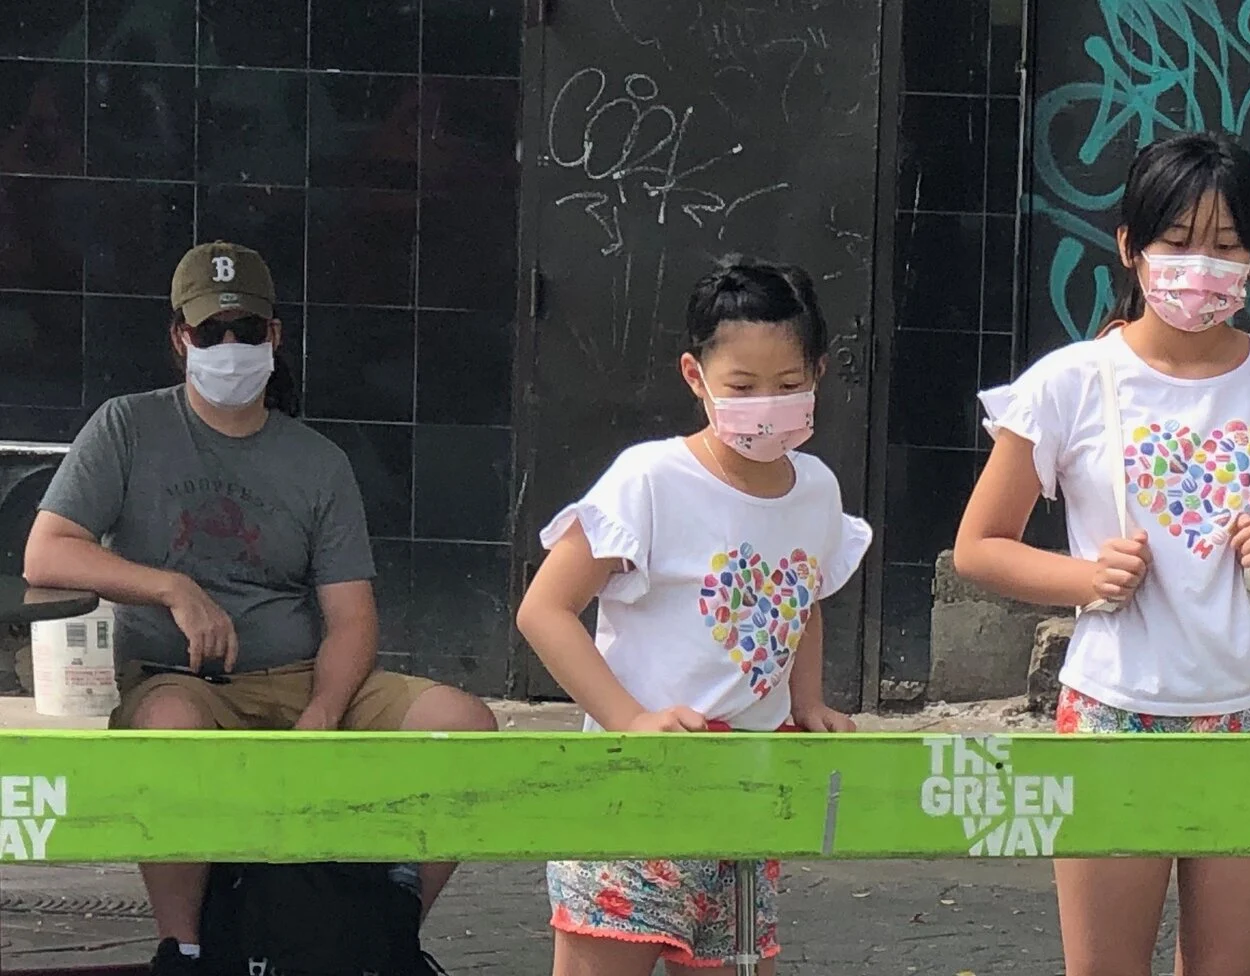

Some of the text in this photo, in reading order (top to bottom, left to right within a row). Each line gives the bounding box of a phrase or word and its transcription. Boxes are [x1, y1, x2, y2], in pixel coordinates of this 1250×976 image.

[211, 256, 236, 282] B
[922, 735, 1013, 775] THE
[921, 775, 1074, 816] GREEN
[962, 816, 1064, 856] WAY
